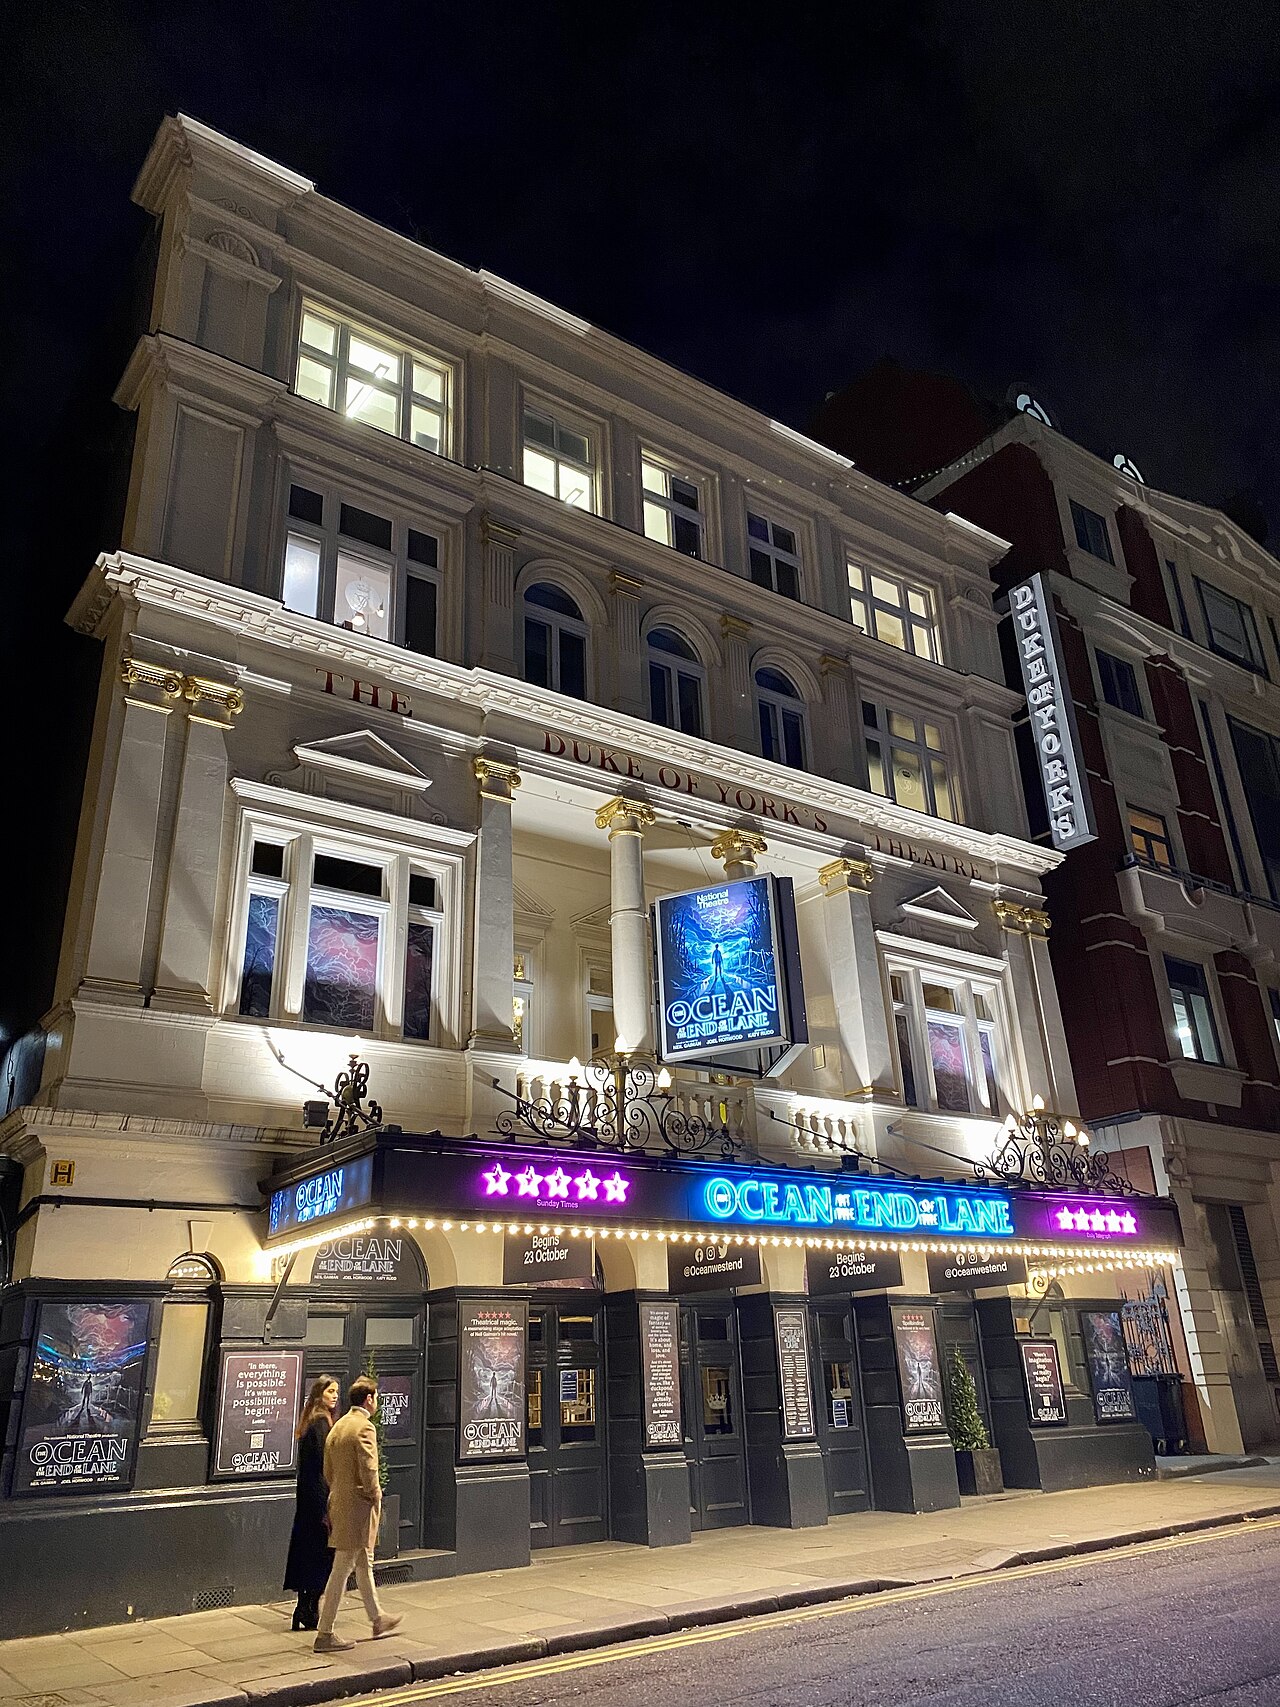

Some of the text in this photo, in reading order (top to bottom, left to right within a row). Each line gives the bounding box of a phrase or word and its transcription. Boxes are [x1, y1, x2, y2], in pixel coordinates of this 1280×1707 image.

[1012, 585, 1049, 683] DUKE
[315, 668, 413, 717] THE
[542, 731, 828, 832] DUKE OF YORK'S
[870, 833, 982, 880] THEATRE
[696, 889, 729, 902] National
[697, 898, 729, 909] Theatre
[666, 985, 777, 1027] OCEAN
[686, 1021, 717, 1039] END
[728, 1012, 770, 1032] LANE
[54, 1163, 72, 1184] H
[296, 1169, 344, 1210] OCEAN
[536, 1198, 579, 1209] Sunday Times
[705, 1177, 834, 1224] OCEAN
[852, 1190, 920, 1228] END
[936, 1196, 1014, 1234] LANE
[316, 1238, 402, 1262] OCEAN
[532, 1234, 560, 1250] Begins
[524, 1247, 569, 1264] 23 October
[836, 1251, 866, 1266] Begins
[328, 1260, 354, 1272] END
[362, 1260, 394, 1272] LANE
[684, 1257, 743, 1278] @Oceanwestend
[828, 1262, 876, 1278] 23 October
[944, 1261, 1008, 1279] @Oceanwestend
[238, 1370, 286, 1380] everything
[246, 1379, 286, 1389] possible.
[233, 1397, 287, 1408] possibilities
[1096, 1391, 1130, 1406] OCEAN
[905, 1401, 941, 1416] OCEAN
[464, 1422, 521, 1440] OCEAN
[30, 1439, 128, 1465] OCEAN
[232, 1452, 280, 1466] OCEAN
[45, 1464, 73, 1476] END
[82, 1461, 117, 1474] LANE
